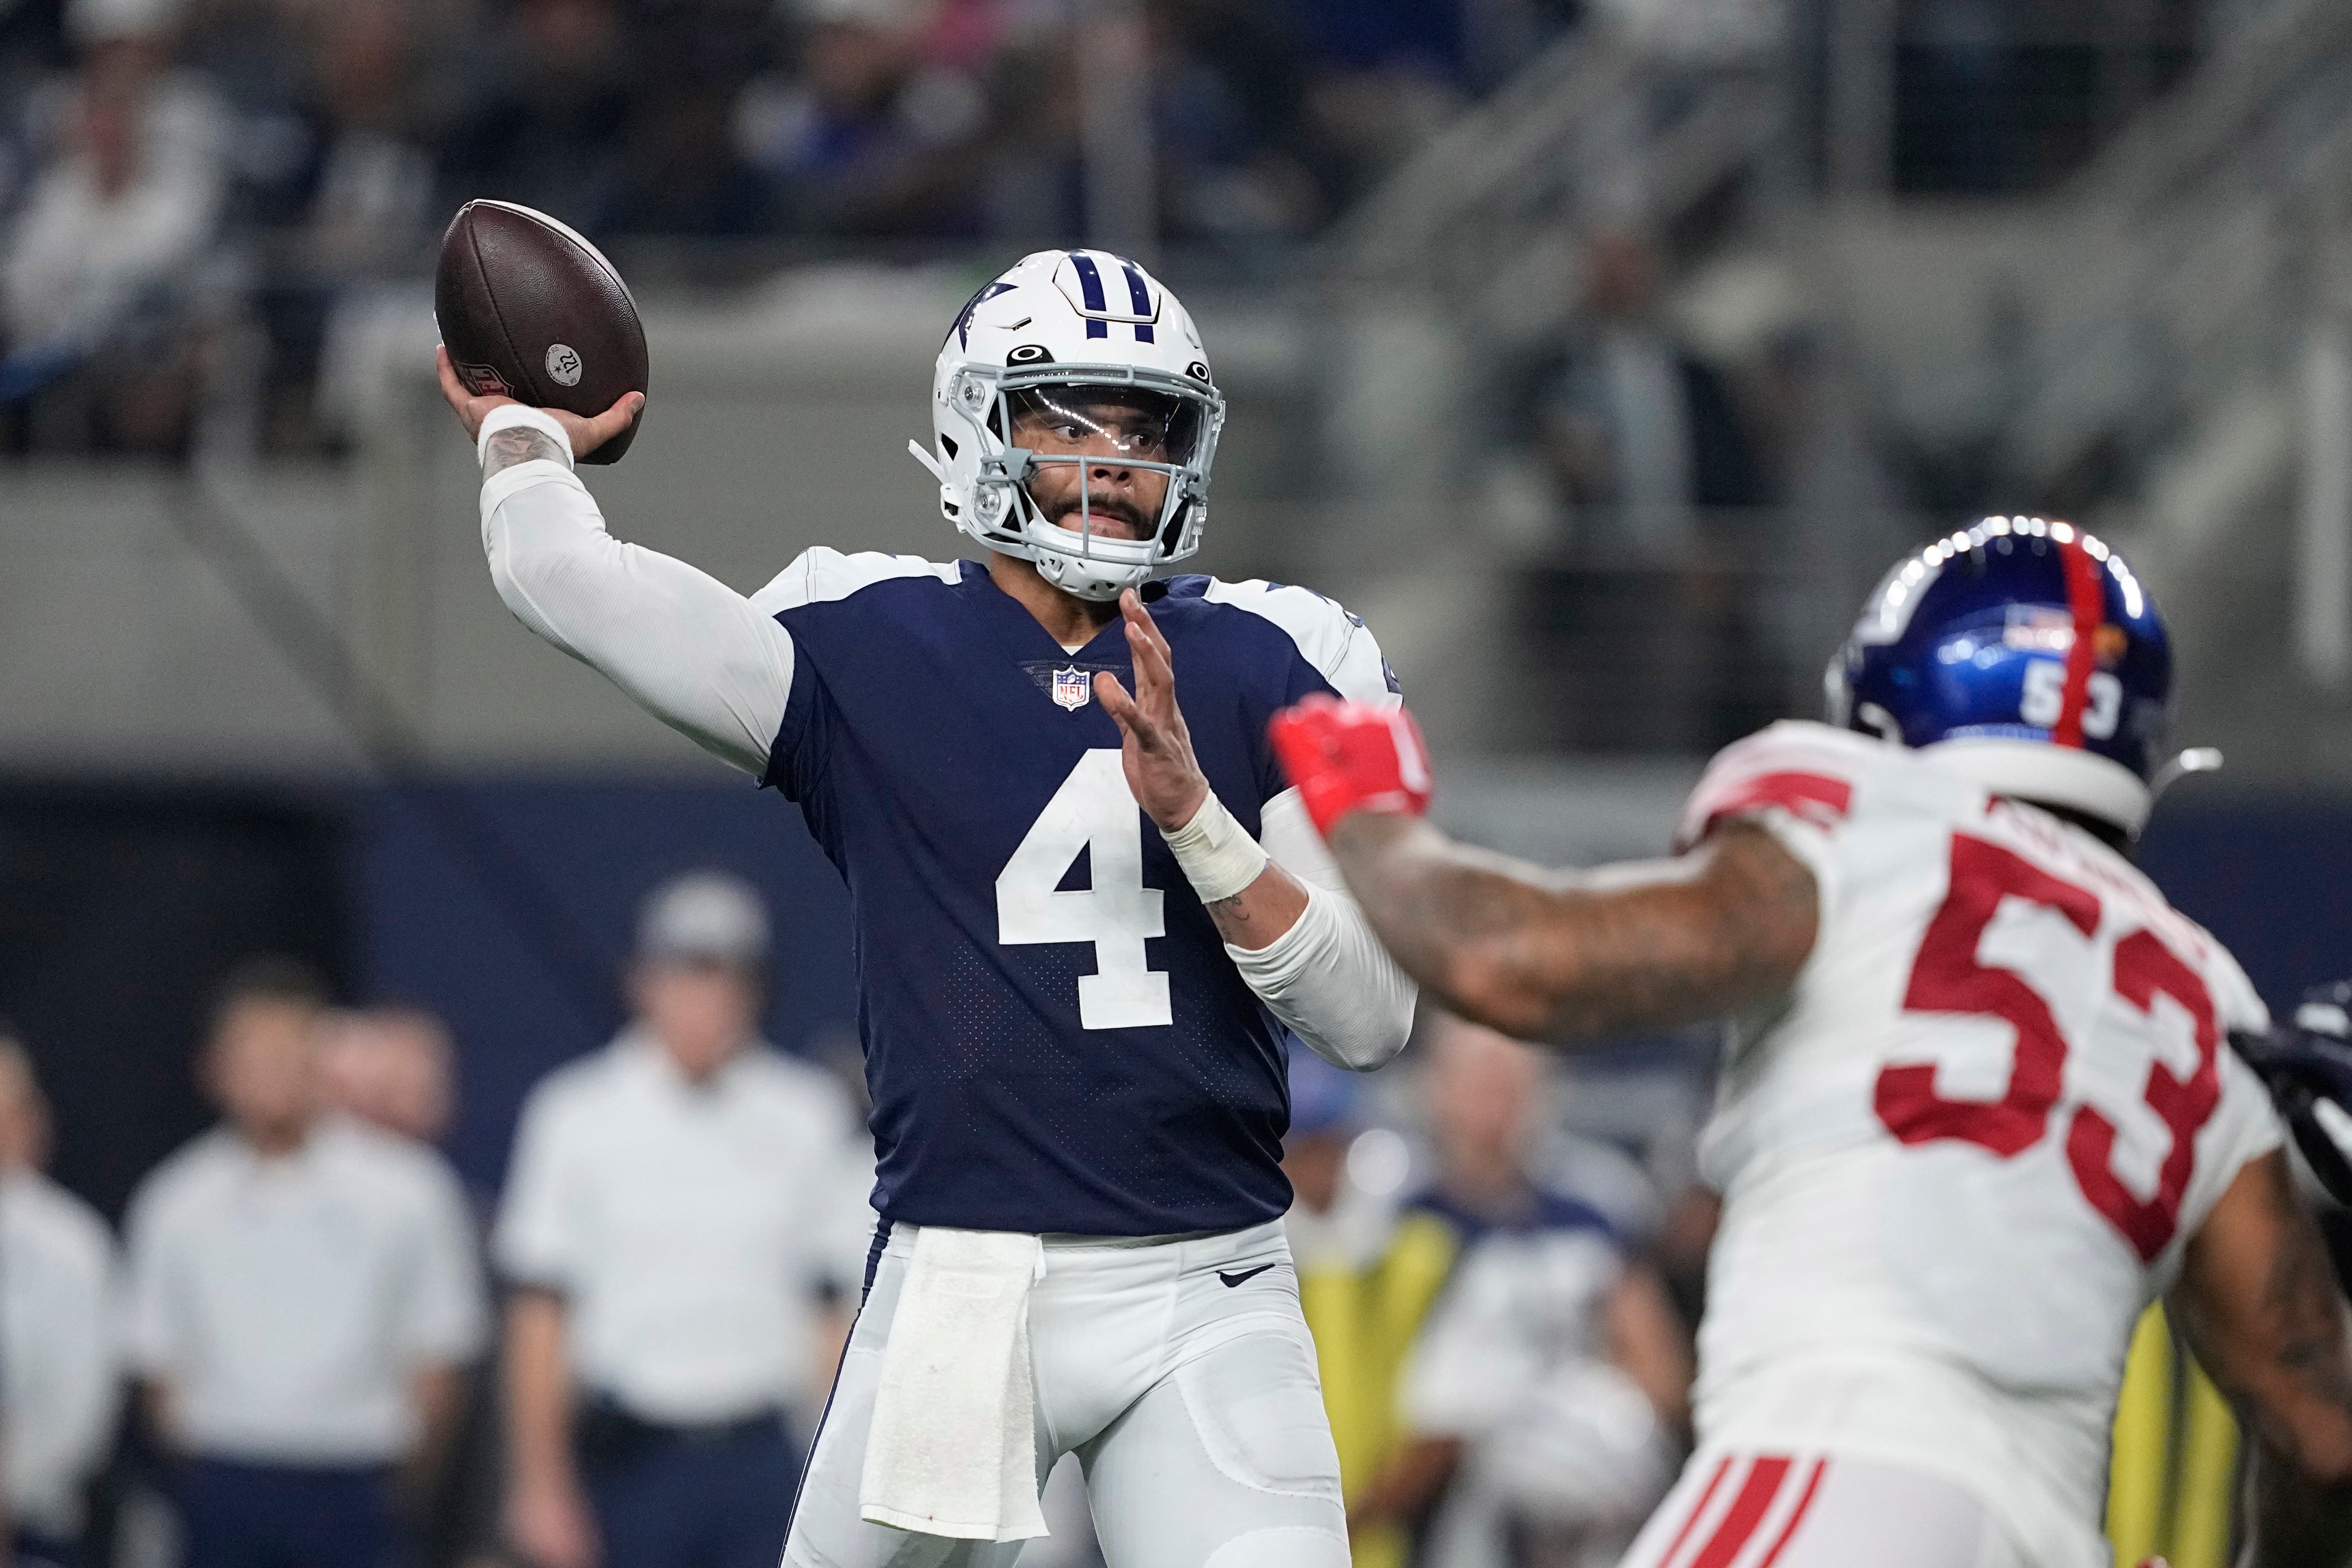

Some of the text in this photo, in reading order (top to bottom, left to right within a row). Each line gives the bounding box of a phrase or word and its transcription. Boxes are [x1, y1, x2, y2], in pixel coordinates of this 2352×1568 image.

[475, 370, 505, 396] FL
[560, 351, 579, 374] 122
[1060, 686, 1083, 702] NFL
[2019, 660, 2123, 740] 53
[995, 748, 1173, 1030] 4
[1874, 830, 2222, 1266] 53
